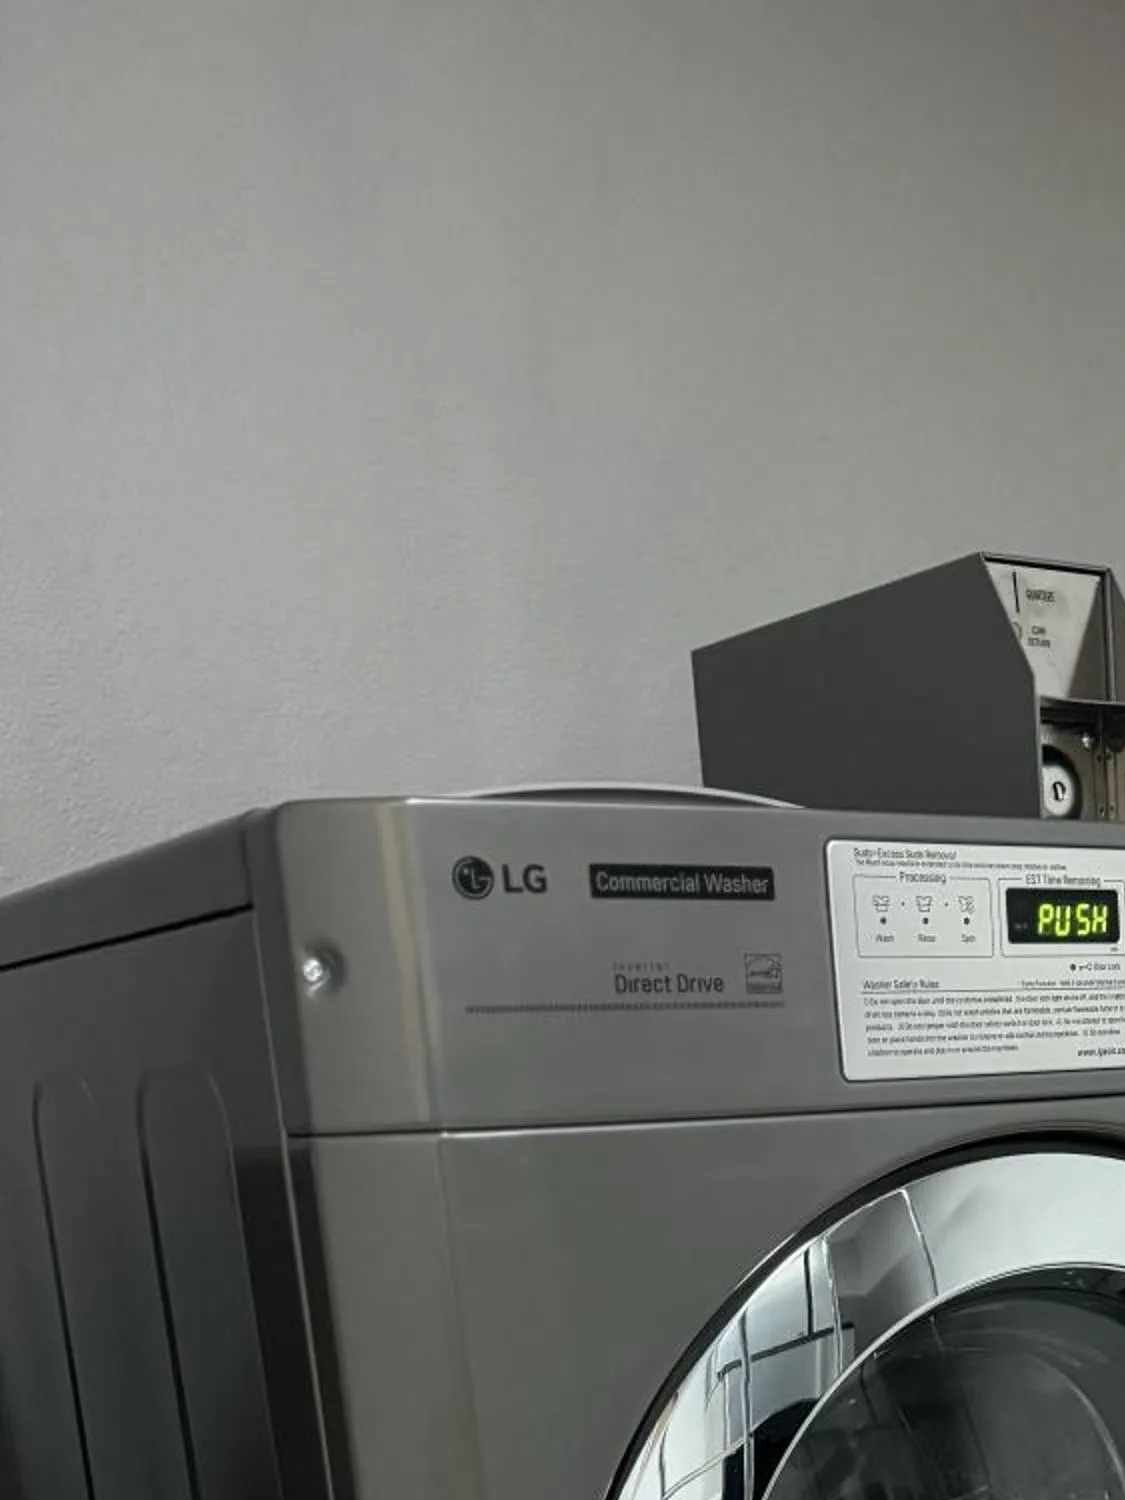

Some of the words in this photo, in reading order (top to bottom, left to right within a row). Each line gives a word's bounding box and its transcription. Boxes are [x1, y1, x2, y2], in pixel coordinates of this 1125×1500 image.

[503, 863, 548, 894] LG
[595, 870, 700, 893] Commercial
[703, 872, 769, 894] Washer
[1037, 903, 1108, 937] PUSH
[615, 973, 671, 994] Direct
[677, 973, 724, 993] Drive
